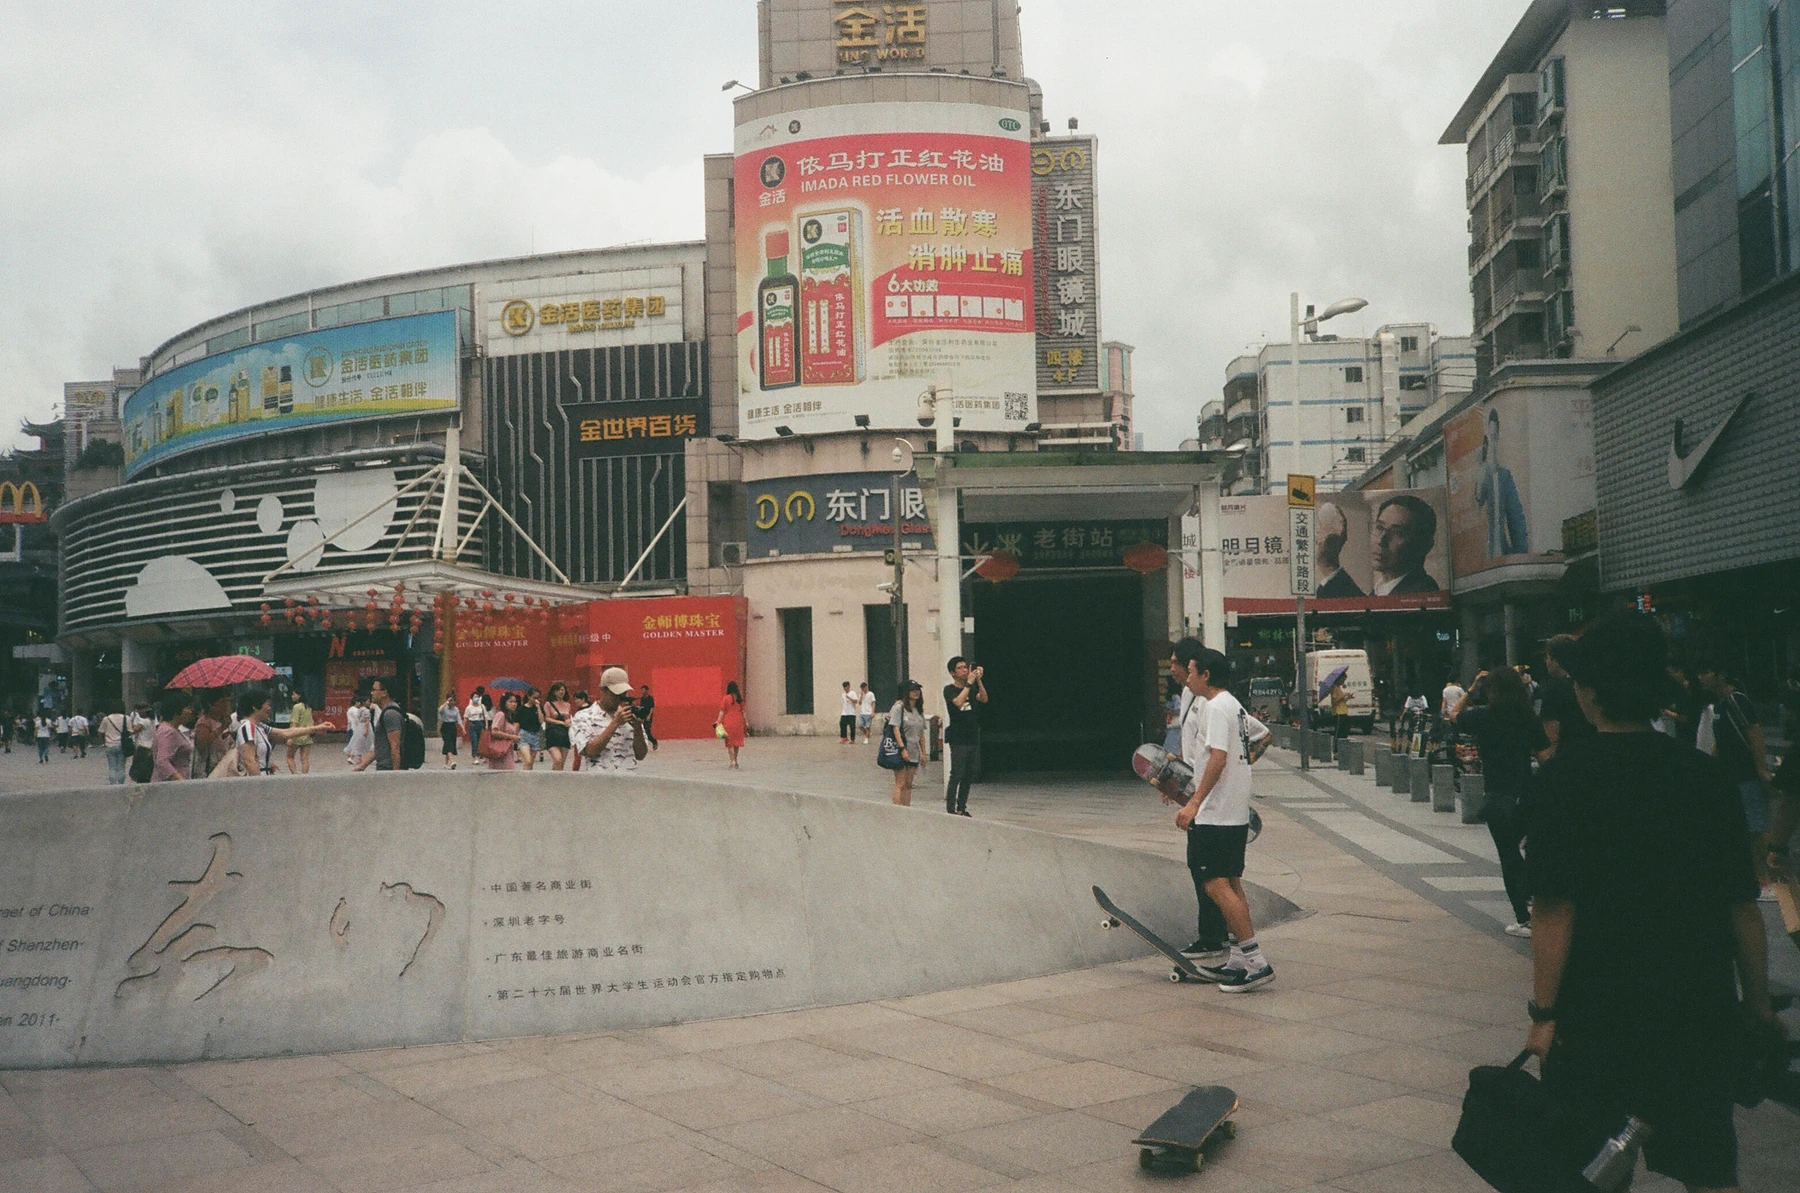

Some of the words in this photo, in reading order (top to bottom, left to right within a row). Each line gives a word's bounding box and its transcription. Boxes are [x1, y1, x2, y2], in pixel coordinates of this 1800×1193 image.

[833, 4, 926, 46] 金活
[1000, 119, 1020, 131] OTC
[797, 149, 1004, 175] 依马打正红花油
[801, 177, 849, 193] IMADA
[852, 175, 882, 187] RED
[886, 173, 949, 186] FLOWER
[952, 174, 976, 187] OIL
[759, 189, 786, 207] 金活
[876, 207, 998, 238] 活血散寒
[908, 242, 1023, 277] 消肿止痛
[1056, 183, 1087, 337] 东门眼镜城
[888, 273, 939, 293] 6大功效
[539, 296, 666, 324] 金活医药集团
[951, 400, 1000, 411] 活医药集团
[579, 414, 697, 442] 金世界百货
[826, 488, 926, 522] 东门眼
[1033, 527, 1113, 548] 老街站
[1182, 533, 1197, 548] 城
[1222, 536, 1290, 556] 明月镜
[1295, 512, 1310, 593] 交通繁忙路段
[494, 640, 528, 648] MASTER
[642, 630, 685, 640] GOLDEN
[689, 628, 724, 638] MASTER
[490, 878, 592, 893] 中国著名商业街
[29, 903, 46, 917] of
[48, 903, 89, 917] China
[492, 913, 566, 928] 深圳老字号
[7, 938, 80, 952] Shenzhen
[494, 944, 644, 964] 广东最佳旅游商业名街
[18, 1012, 56, 1027] 2011
